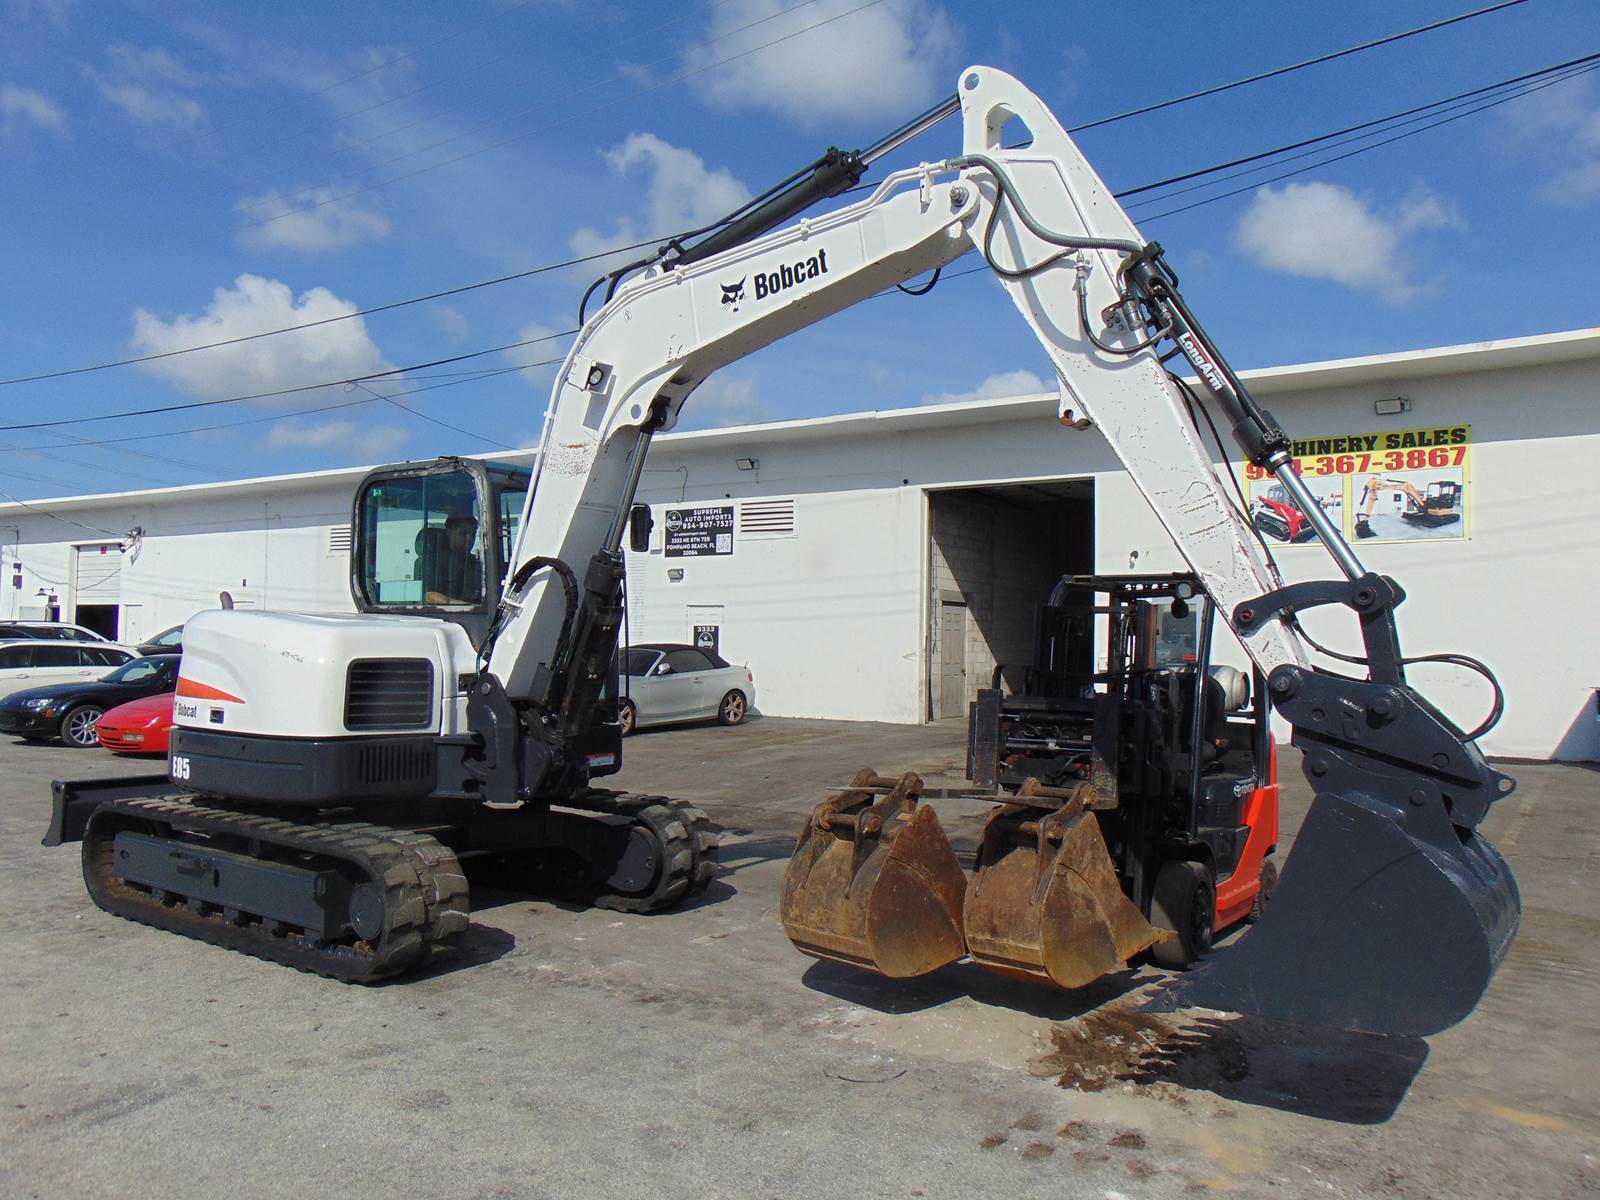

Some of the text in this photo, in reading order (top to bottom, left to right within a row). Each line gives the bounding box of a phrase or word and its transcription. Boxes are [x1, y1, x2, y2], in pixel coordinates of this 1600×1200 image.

[754, 248, 828, 300] Bobcat
[1289, 428, 1466, 457] HINERY SALES
[693, 508, 722, 516] SUPREME
[682, 520, 733, 529] 954-907-7527
[178, 703, 198, 718] Bobcat
[172, 756, 190, 779] E85
